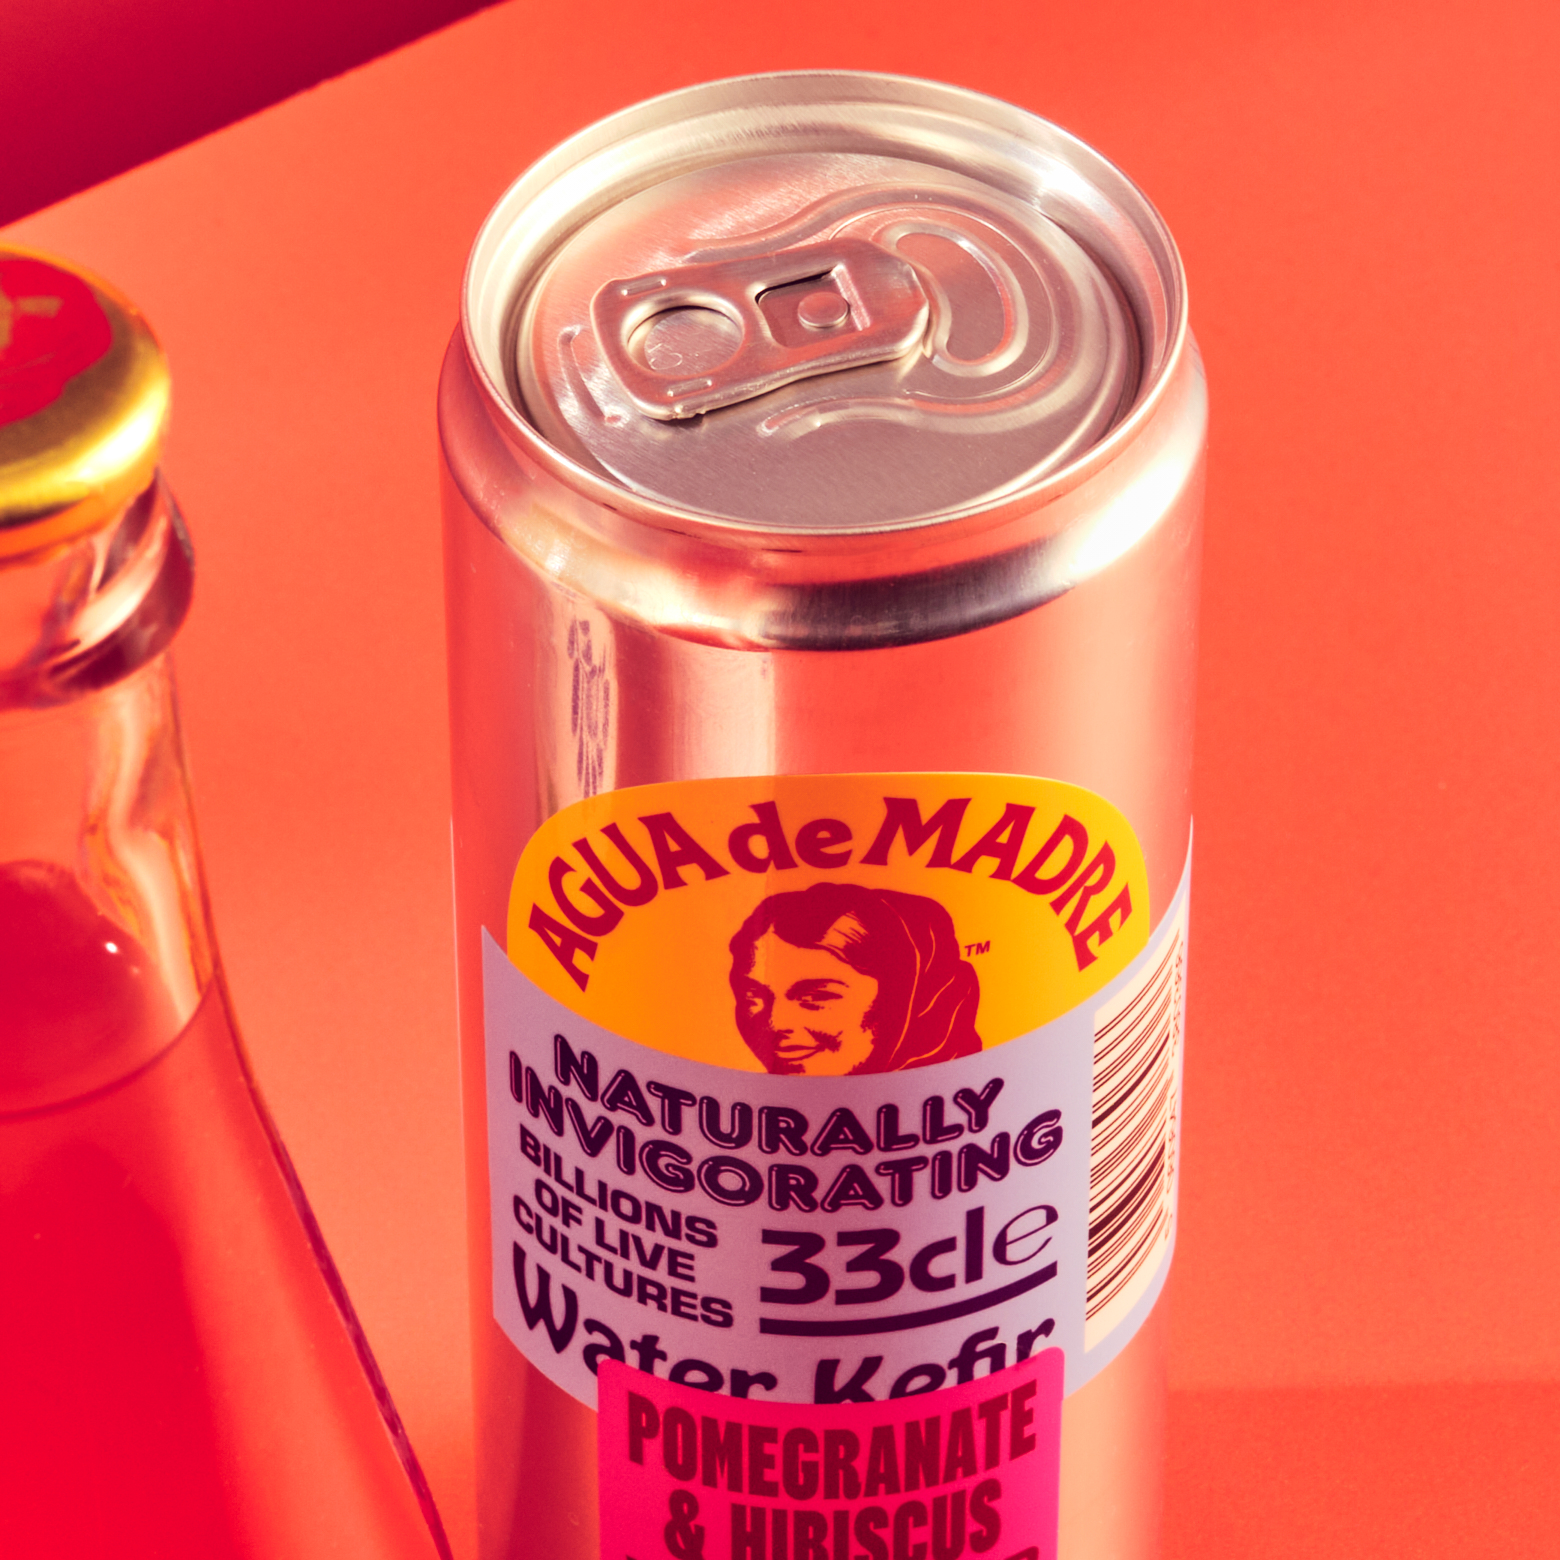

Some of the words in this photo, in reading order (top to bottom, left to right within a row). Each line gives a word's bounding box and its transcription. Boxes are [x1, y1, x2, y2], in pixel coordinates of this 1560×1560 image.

[528, 811, 729, 991] AGUA
[727, 800, 854, 875] de
[857, 797, 1134, 972] MADRE
[508, 1050, 1064, 1214] INVIGORATING
[553, 1034, 1005, 1157] NATURALLY
[519, 1124, 719, 1250] BILLIONS
[533, 1178, 583, 1229] OF
[594, 1217, 696, 1285] LIVE
[512, 1194, 734, 1329] CULTURES
[513, 1241, 778, 1400] Water
[628, 1379, 1038, 1501] POMEGRANATE
